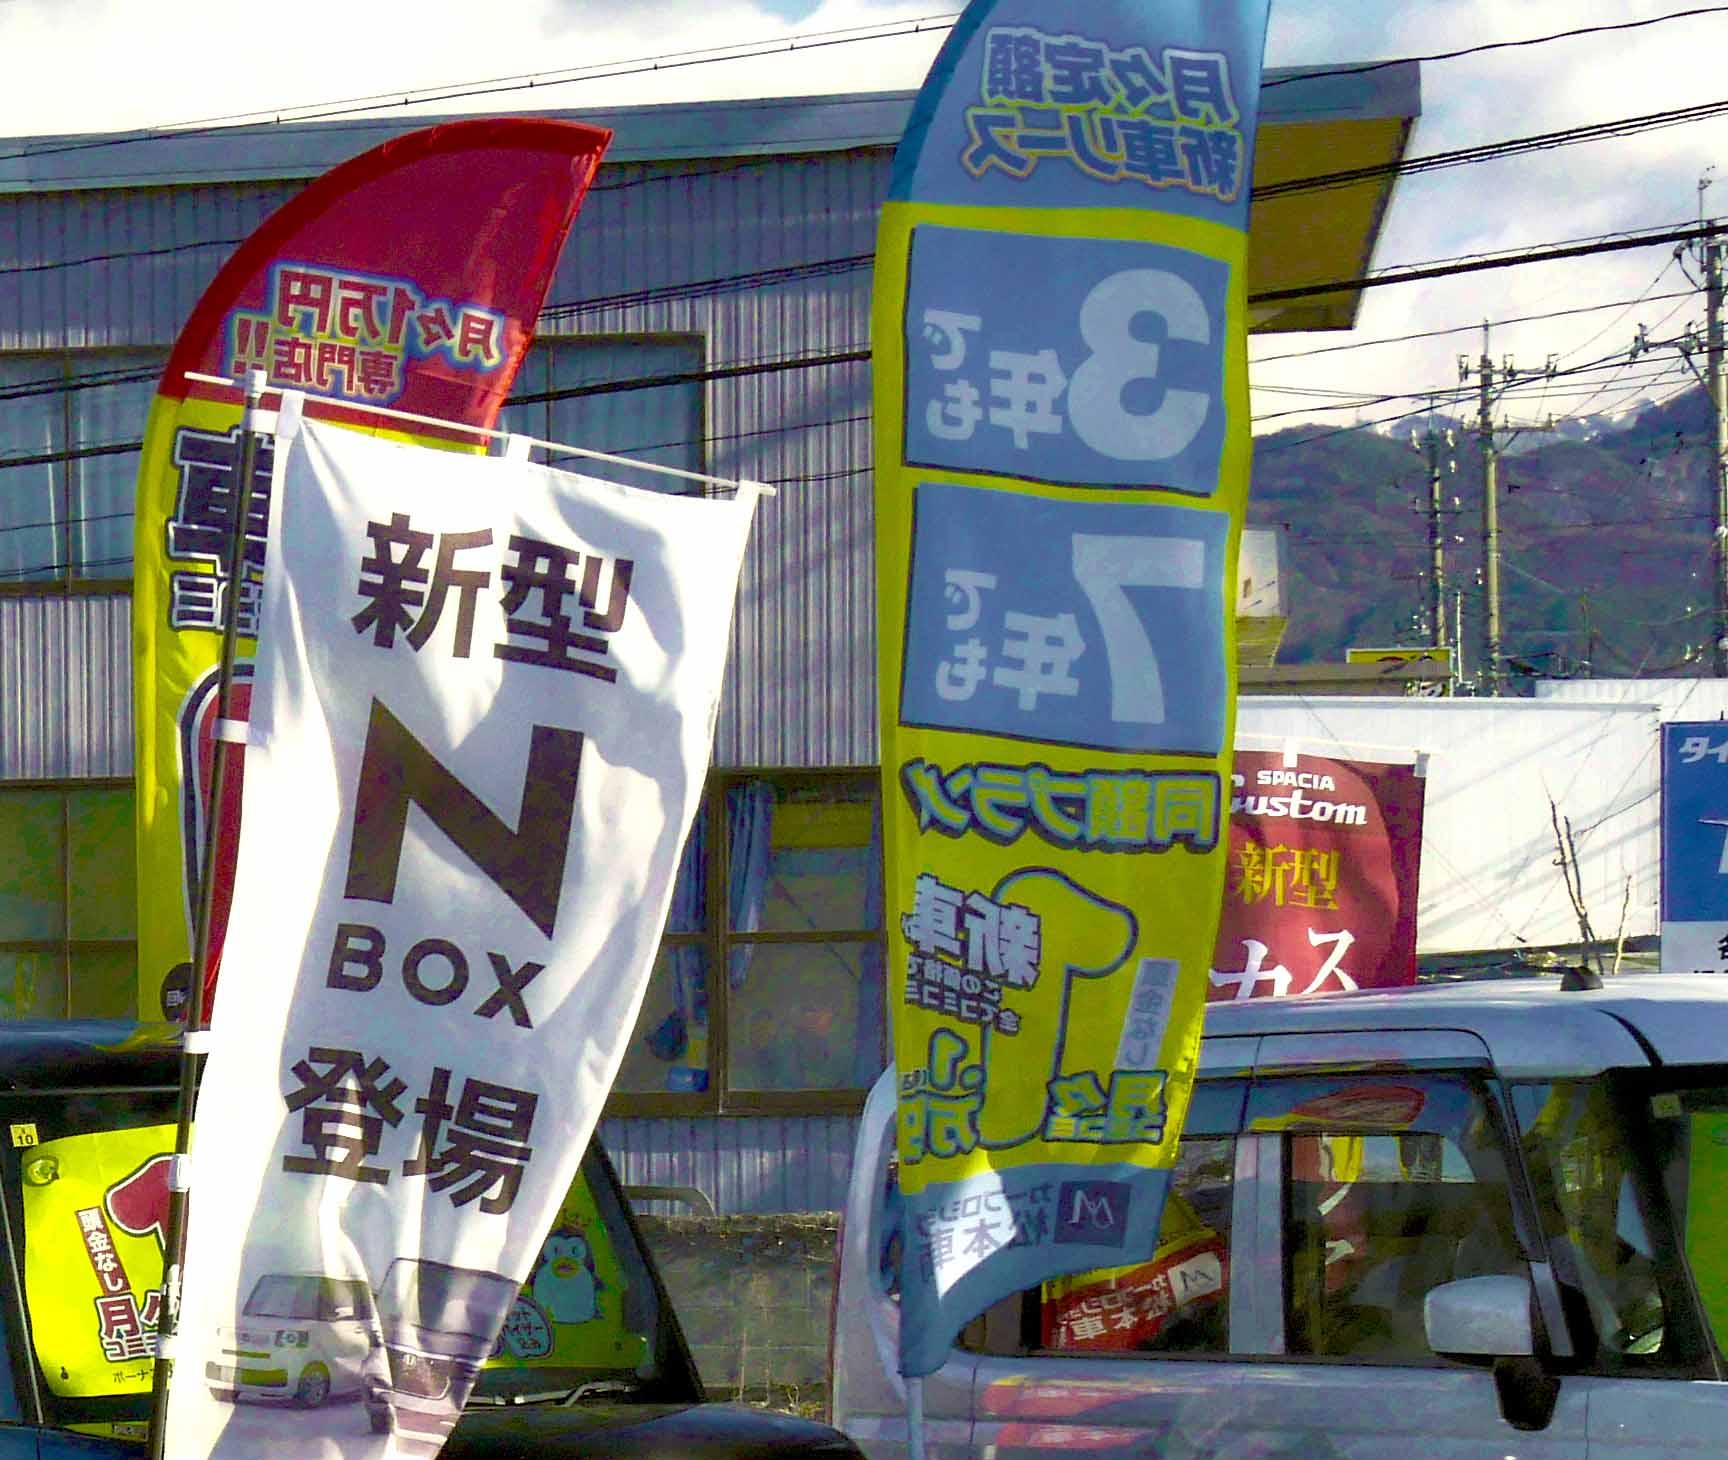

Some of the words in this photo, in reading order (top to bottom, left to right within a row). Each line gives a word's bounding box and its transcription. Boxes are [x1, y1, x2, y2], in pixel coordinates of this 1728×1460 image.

[351, 512, 635, 683] 新型
[344, 696, 585, 940] N
[1257, 770, 1336, 791] SPACIA
[1232, 838, 1342, 911] 新型
[326, 923, 547, 1030] BOX
[282, 1046, 540, 1216] 登場
[78, 1209, 127, 1294] 頭金なし
